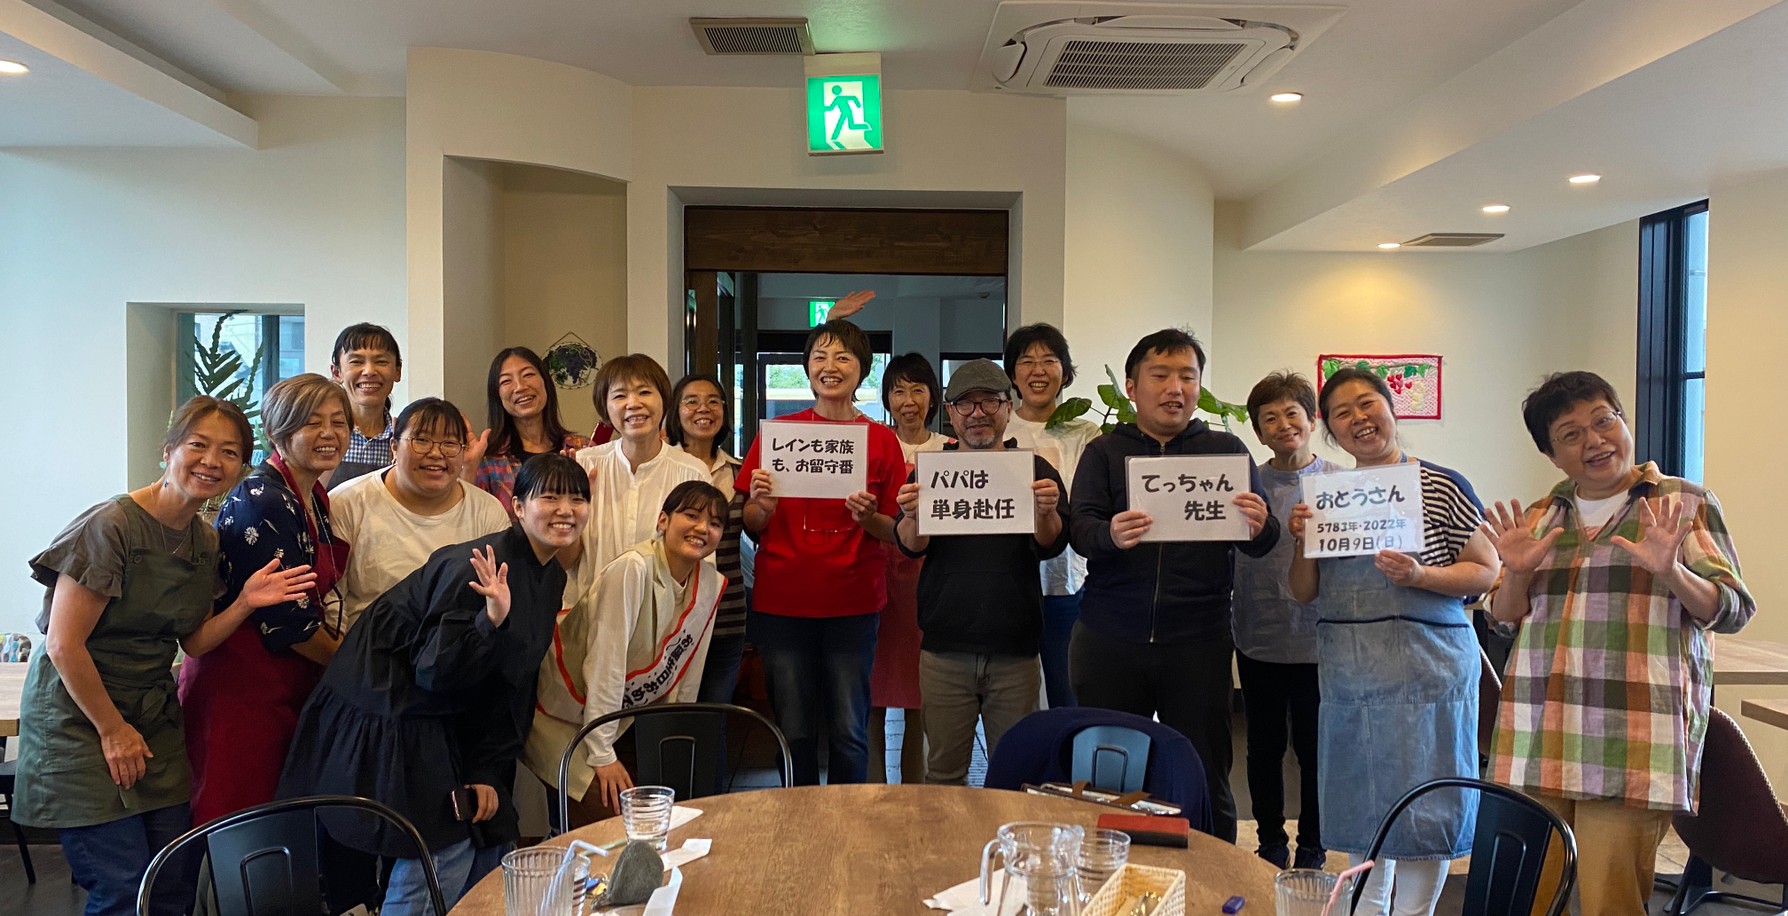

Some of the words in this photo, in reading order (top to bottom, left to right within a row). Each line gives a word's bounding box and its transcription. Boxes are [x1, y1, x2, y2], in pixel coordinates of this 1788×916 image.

[772, 437, 855, 455] レインも家族
[771, 458, 854, 475] も、お留守番
[930, 469, 989, 490] パパは
[1141, 473, 1234, 493] てっちゃん
[1315, 484, 1406, 511] おとうさん
[930, 498, 1016, 520] 単身赴任
[1183, 500, 1227, 521] 先生
